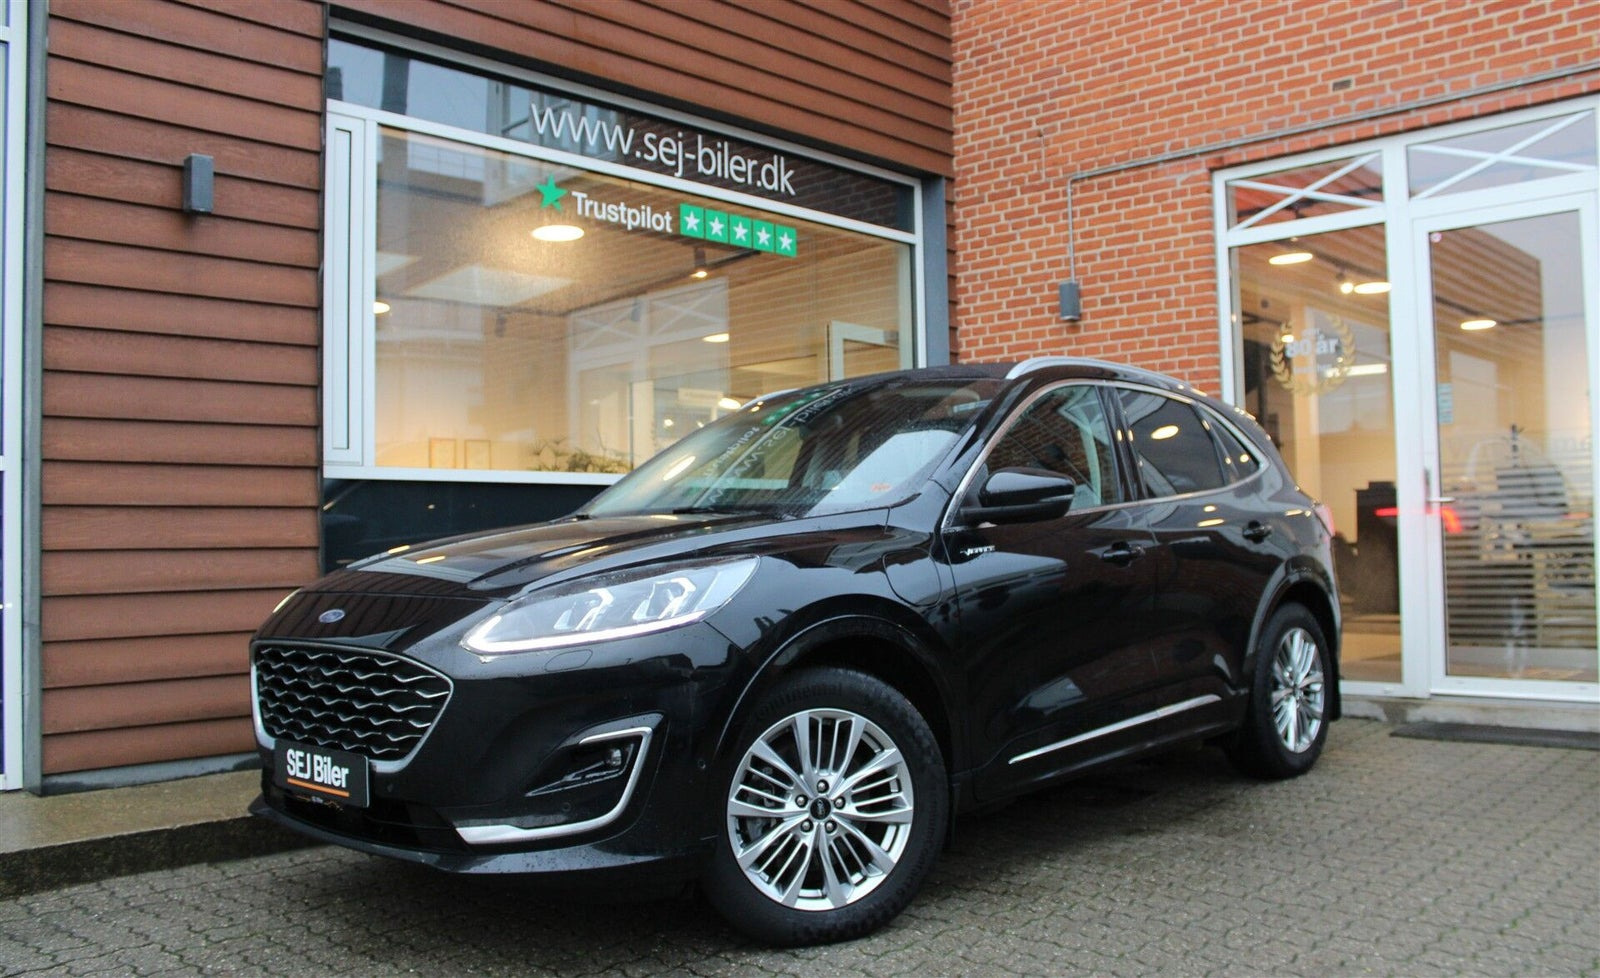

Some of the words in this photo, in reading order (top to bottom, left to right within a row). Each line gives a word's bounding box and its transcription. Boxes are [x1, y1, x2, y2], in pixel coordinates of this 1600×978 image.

[531, 103, 797, 196] www.sej-biler.dk
[571, 191, 673, 233] Trustpilot
[287, 748, 311, 779] SEJ
[313, 754, 349, 788] Biler
